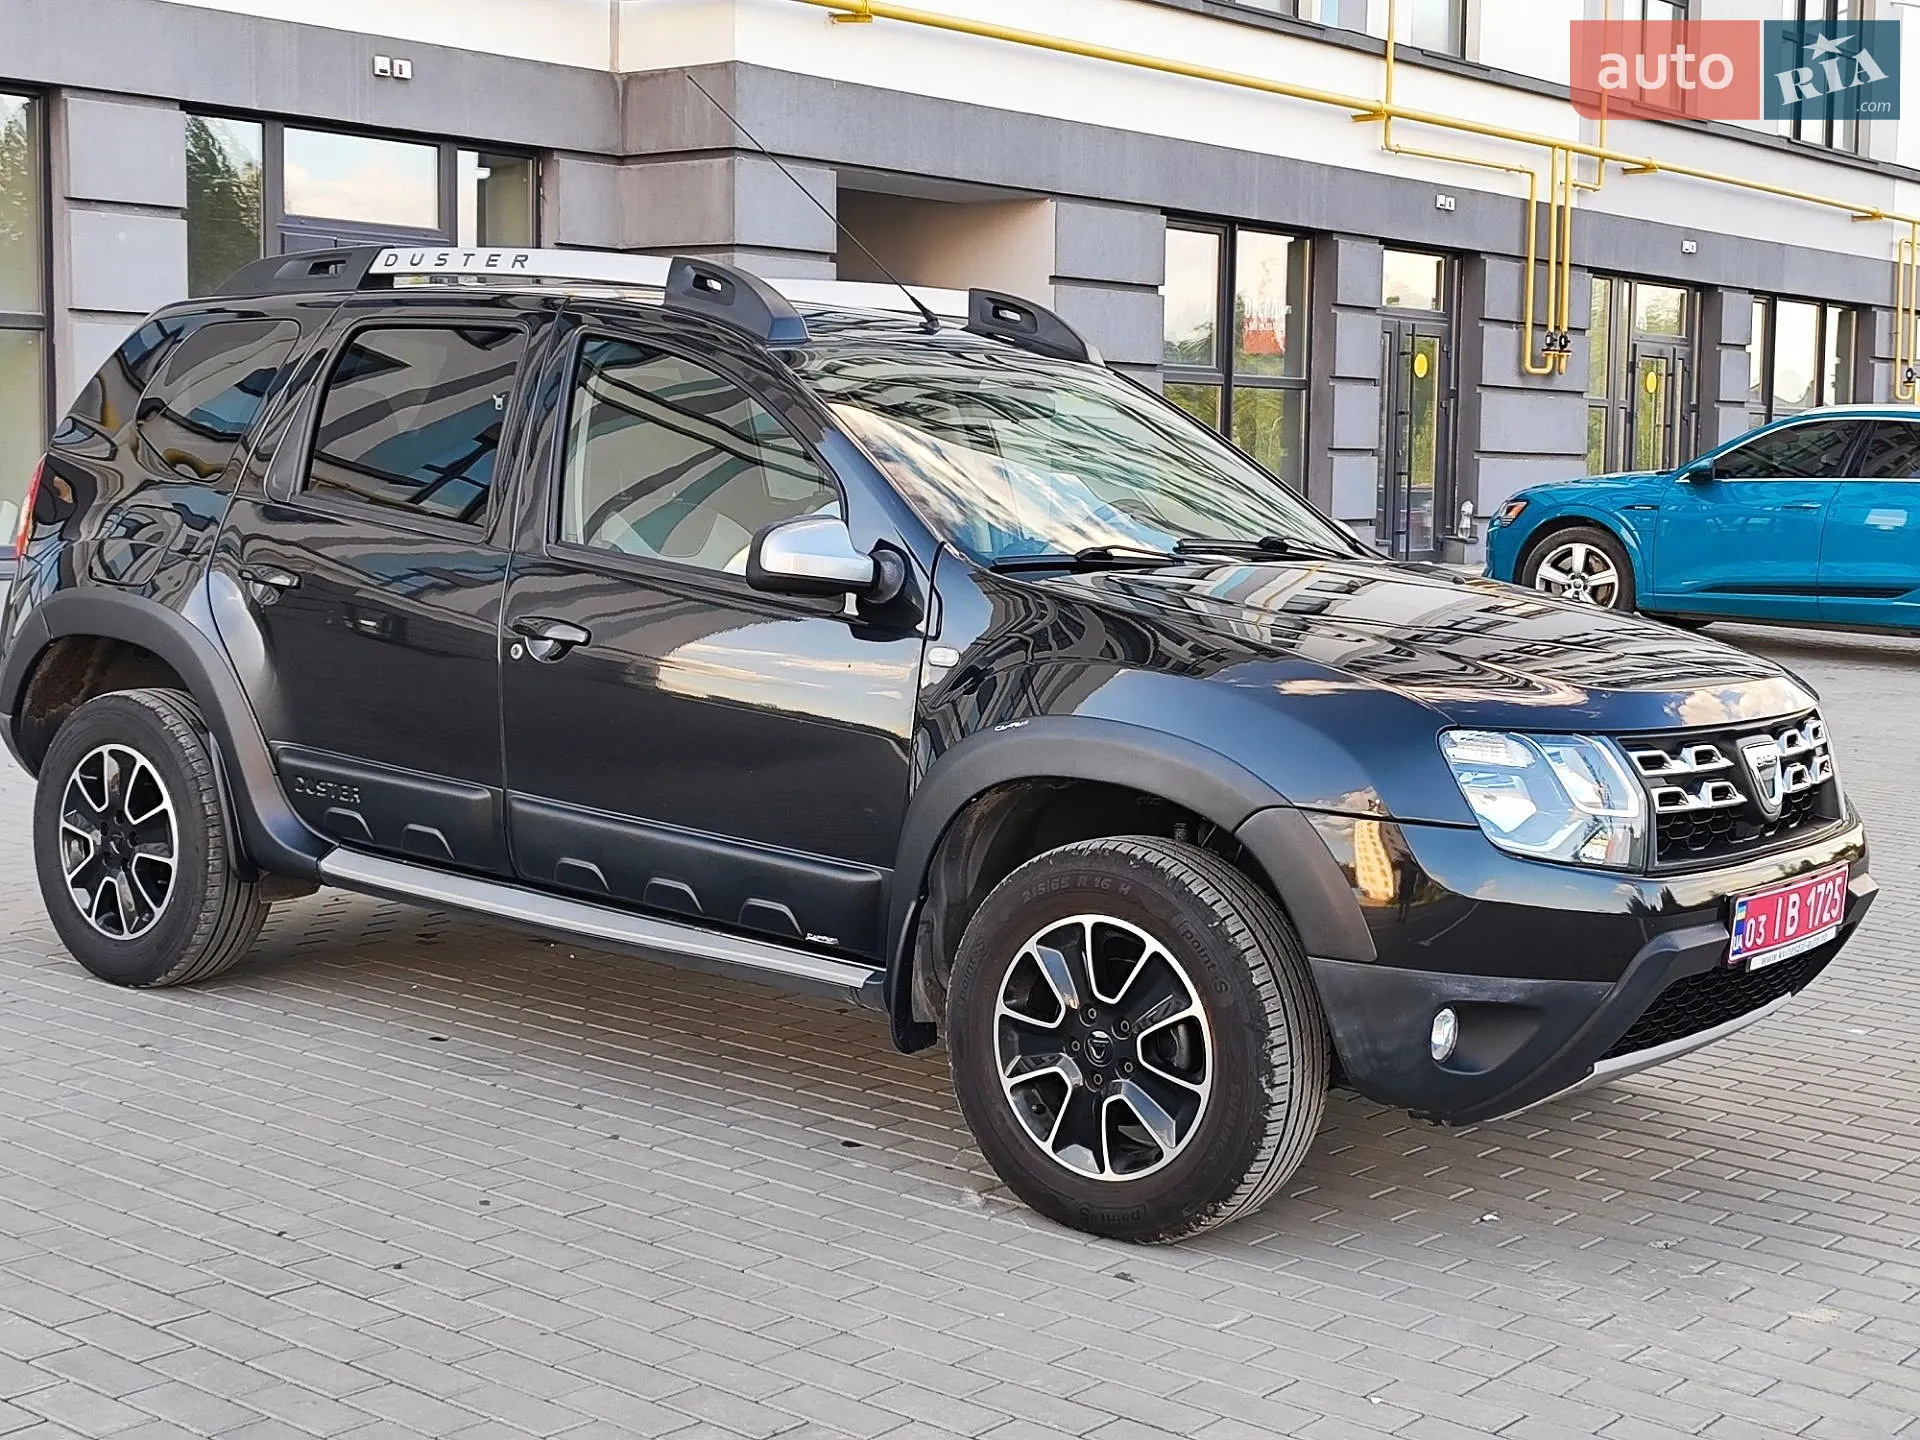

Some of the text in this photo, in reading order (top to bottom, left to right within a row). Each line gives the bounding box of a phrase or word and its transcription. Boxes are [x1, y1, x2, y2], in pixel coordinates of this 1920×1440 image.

[384, 253, 529, 269] DUSTER
[294, 776, 361, 804] DUSTER
[1745, 914, 1767, 949] 03
[1773, 893, 1801, 940] IB
[1806, 876, 1843, 929] 1725
[1733, 935, 1743, 951] UA
